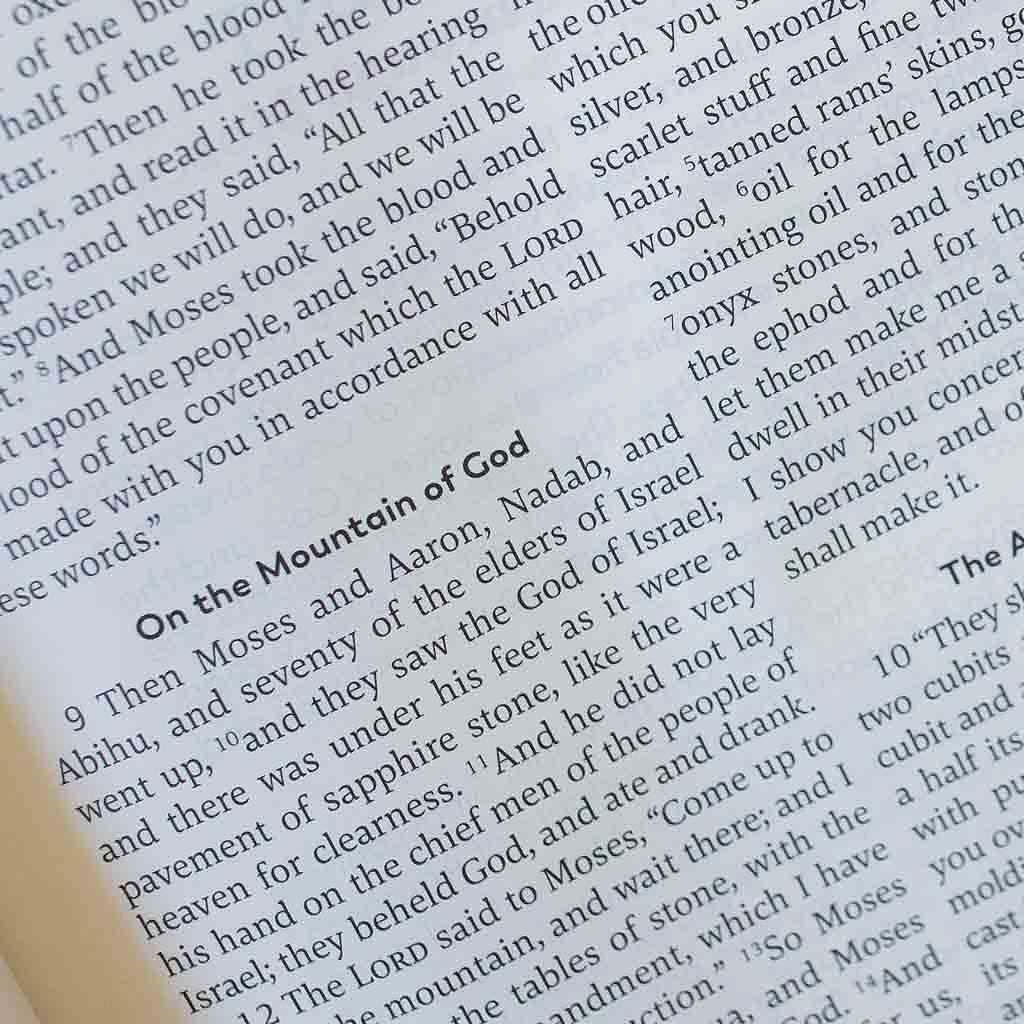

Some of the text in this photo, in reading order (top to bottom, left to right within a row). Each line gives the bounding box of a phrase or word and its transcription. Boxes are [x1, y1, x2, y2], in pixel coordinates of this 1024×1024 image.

[17, 37, 51, 78] of
[65, 17, 121, 56] the
[547, 31, 649, 93] which
[655, 2, 721, 53] you
[590, 114, 694, 178] scarlet
[703, 66, 776, 126] stuff
[787, 35, 849, 87] and
[857, 11, 921, 54] fine
[649, 215, 804, 302] anointing
[808, 184, 851, 225] oil
[857, 152, 918, 203] and
[923, 134, 969, 171] for
[135, 429, 530, 641] On the Mountain of God
[763, 450, 929, 541] tabernacle,
[936, 407, 996, 456] and
[784, 473, 980, 580] shall make it.
[59, 452, 705, 786] Abihu, and seventy of the elders of Israel
[938, 550, 1002, 585] The
[872, 643, 911, 678] 10
[118, 578, 755, 910] pavement of sapphire stone, like the very
[911, 797, 980, 841] with
[511, 806, 870, 1005] tables of stone, with the
